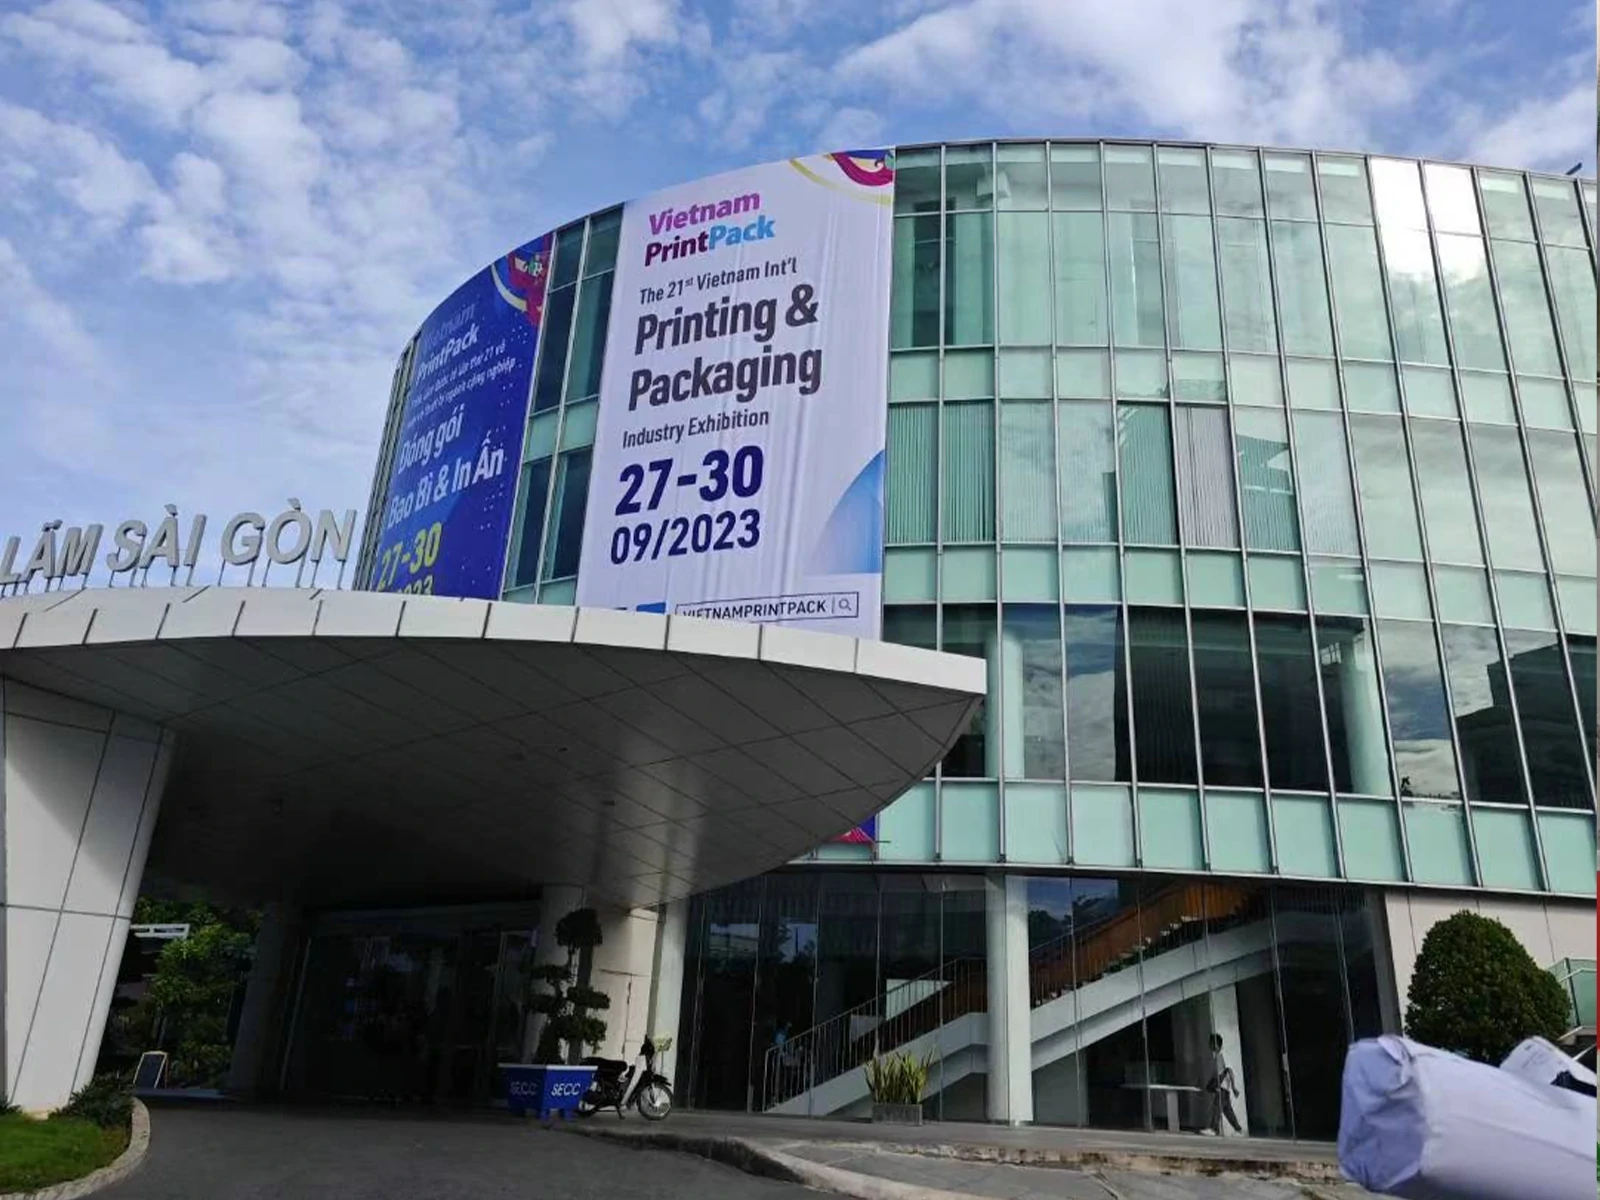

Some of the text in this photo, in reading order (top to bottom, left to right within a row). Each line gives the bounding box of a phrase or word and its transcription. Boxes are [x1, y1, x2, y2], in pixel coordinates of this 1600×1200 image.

[644, 215, 776, 267] PrintPack
[649, 191, 760, 236] Vietnam
[640, 256, 798, 305] The 21st Vietnam Int'l
[634, 283, 819, 356] Printing &
[415, 322, 480, 386] PrintPack
[628, 344, 822, 412] Packaging
[433, 404, 465, 458] gói
[622, 409, 769, 449] Industry Exhibition
[387, 492, 413, 528] Bao
[433, 464, 450, 502] &
[451, 458, 472, 493] In
[472, 430, 504, 485] Ấn
[614, 445, 764, 516] 27-30
[107, 503, 207, 572] SÀI
[221, 498, 357, 566] GÒN
[376, 521, 442, 592] 27-30
[610, 508, 761, 565] 09/2023
[510, 1081, 539, 1096] SECC
[551, 1082, 581, 1097] SECC
